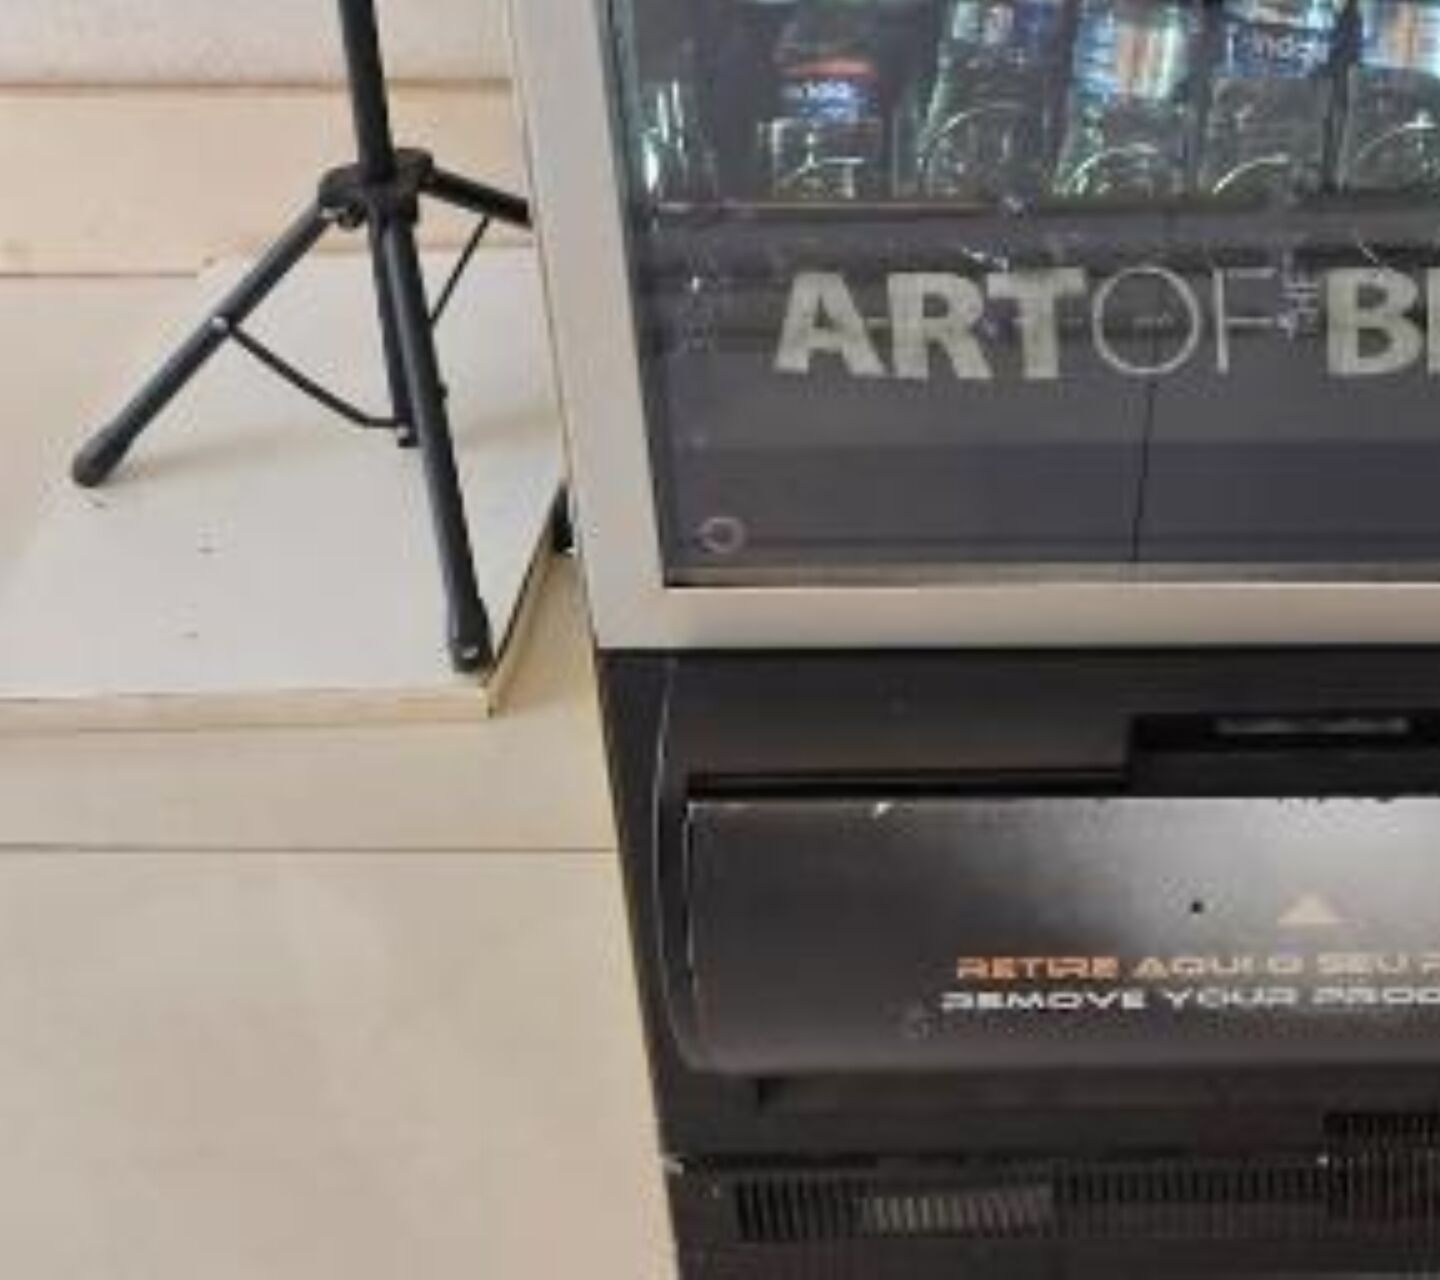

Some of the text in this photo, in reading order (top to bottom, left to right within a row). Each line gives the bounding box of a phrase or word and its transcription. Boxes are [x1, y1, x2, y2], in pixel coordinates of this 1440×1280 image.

[775, 269, 1085, 381] ART
[1090, 264, 1278, 376] OF
[956, 955, 1118, 981] RETIRE
[1131, 954, 1256, 978] AQUI
[1267, 955, 1303, 975] O
[1316, 950, 1407, 974] SEU
[941, 989, 1147, 1011] REMOVE
[1164, 987, 1298, 1010] YOUR
